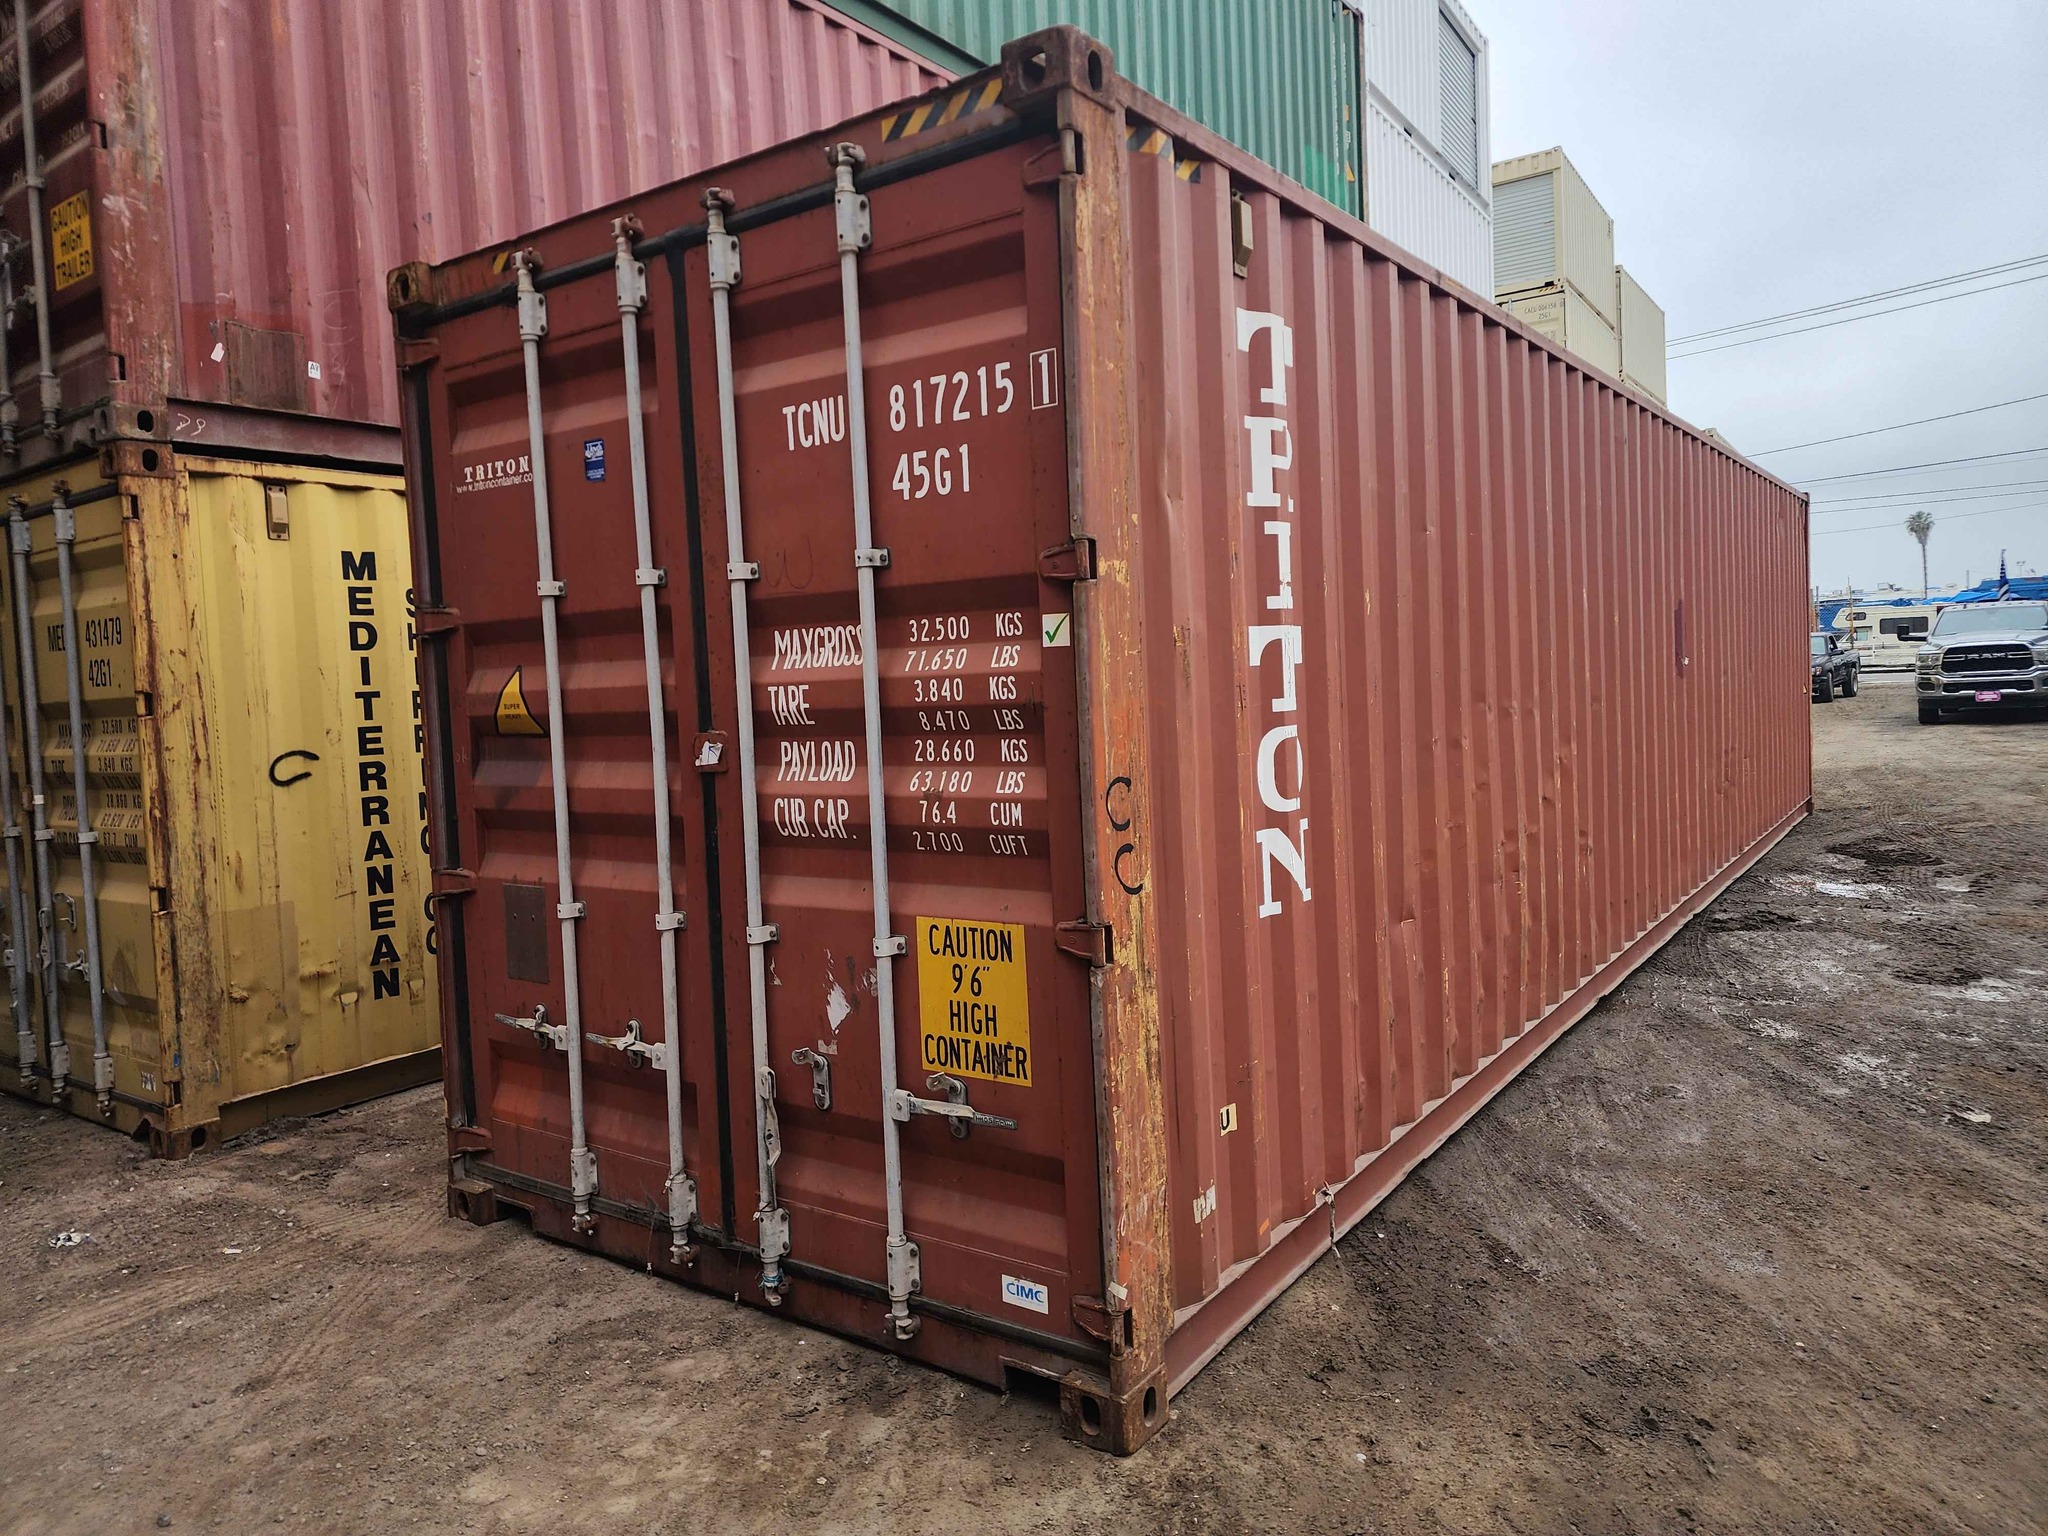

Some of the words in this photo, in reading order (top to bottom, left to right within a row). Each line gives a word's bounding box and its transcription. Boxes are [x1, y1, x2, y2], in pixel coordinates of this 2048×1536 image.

[51, 191, 88, 232] CAUTION
[60, 224, 82, 257] HIGH
[56, 249, 92, 287] TRAILER
[782, 394, 846, 451] TCNU
[889, 361, 1014, 432] 817215
[456, 472, 533, 493] www.tritoncontainer.co
[464, 455, 530, 482] TRITON
[892, 443, 970, 501] 45G1
[85, 616, 122, 648] 431479
[908, 615, 970, 642] 32,500
[994, 612, 1023, 637] KGS
[88, 658, 112, 688] 42G1
[904, 647, 968, 672] 71,650
[990, 645, 1021, 669] LBS
[768, 684, 815, 726] TARE
[914, 677, 963, 703] 3,840
[989, 675, 1017, 700] KGS
[918, 710, 971, 732] 8,470
[993, 709, 1025, 731] LBS
[121, 757, 133, 772] KGS
[340, 550, 401, 1000] MEDITERRANEAN
[776, 740, 857, 782] PAYLOAD
[914, 739, 975, 764] 28,660
[1000, 739, 1029, 763] KGS
[909, 770, 973, 793] 63,180
[995, 770, 1026, 794] LBS
[126, 813, 142, 829] LBS
[919, 801, 957, 824] 76.4
[990, 802, 1023, 827] CUM
[124, 833, 139, 848] CUM
[988, 834, 1030, 856] CUFT
[929, 924, 1013, 963] CAUTION
[950, 999, 998, 1037] HIGH
[924, 1033, 1029, 1080] CONTAINER
[1006, 1282, 1044, 1304] CIMC
